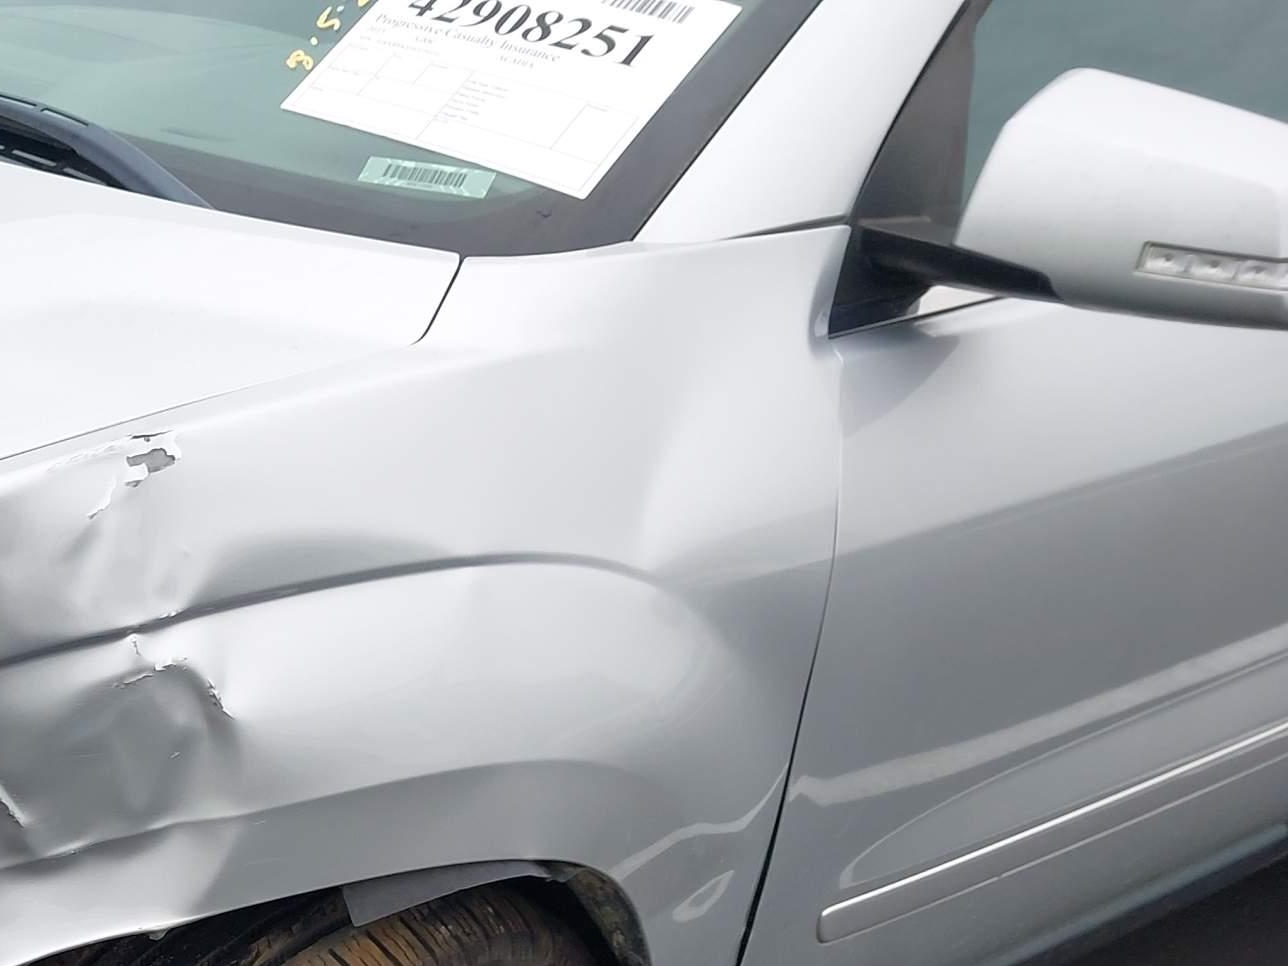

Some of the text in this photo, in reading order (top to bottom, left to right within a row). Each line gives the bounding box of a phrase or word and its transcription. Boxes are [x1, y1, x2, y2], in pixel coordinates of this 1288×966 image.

[374, 13, 443, 35] Progressive
[443, 27, 496, 48] Casualty
[499, 38, 561, 62] Insurance
[408, 0, 654, 68] 42908251
